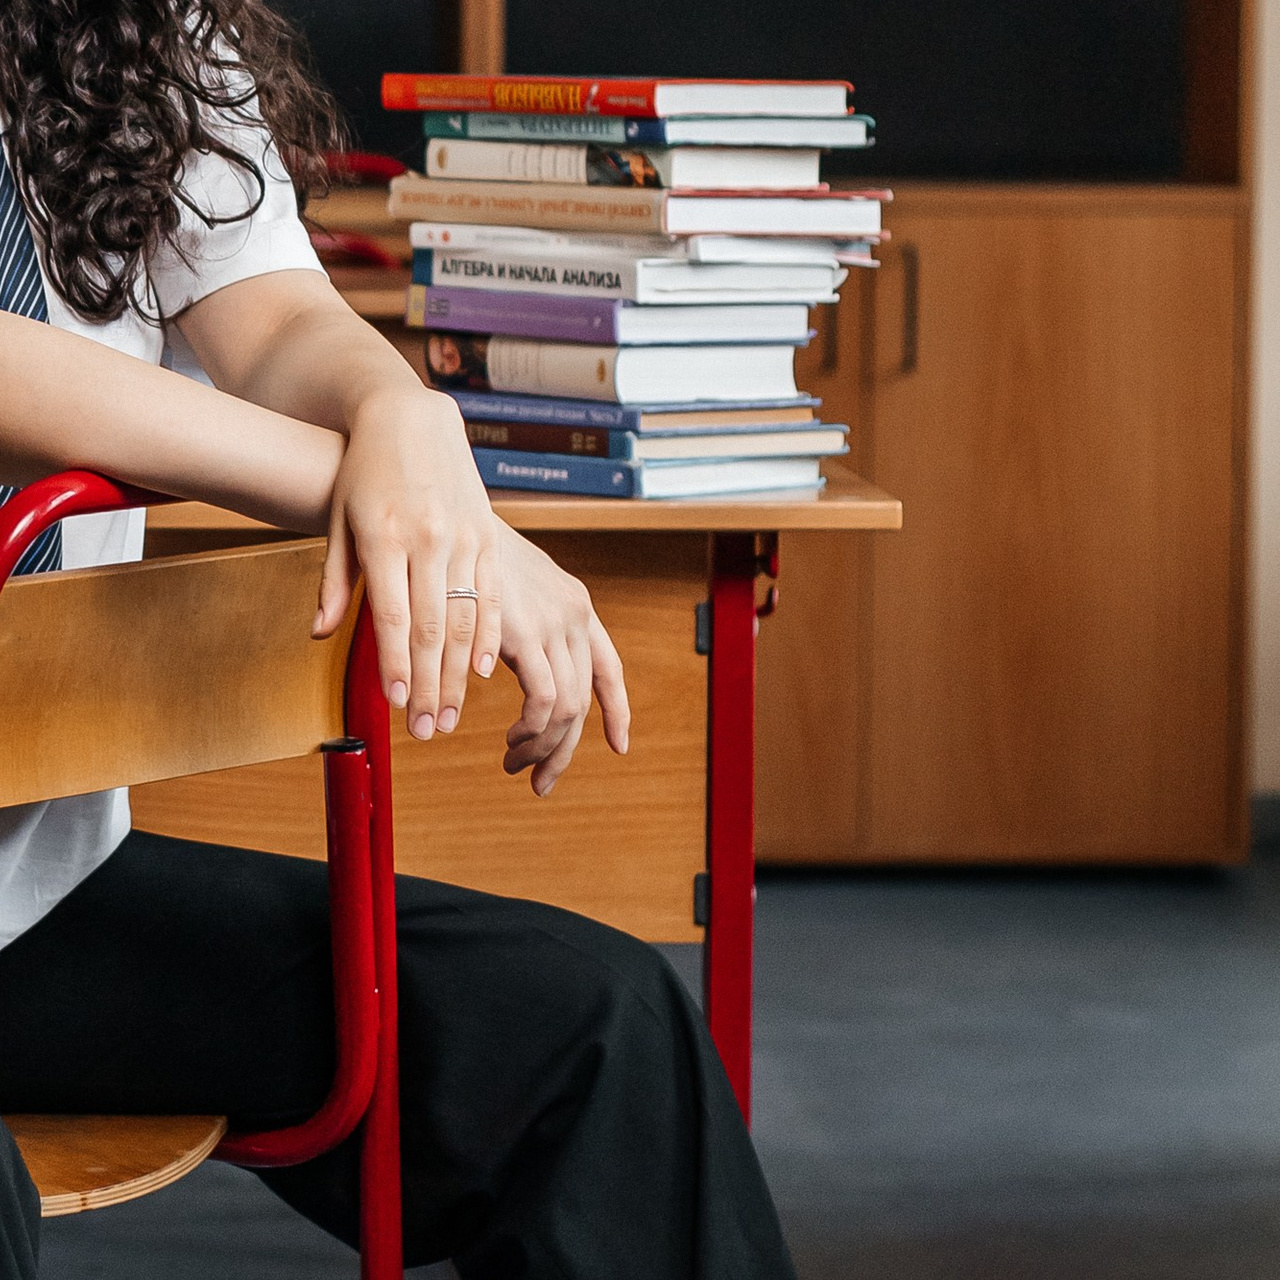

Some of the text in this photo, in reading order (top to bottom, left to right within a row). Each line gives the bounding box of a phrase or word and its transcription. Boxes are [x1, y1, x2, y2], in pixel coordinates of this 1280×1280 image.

[441, 258, 622, 289] АЛГЕБРА И НАЧАЛА АНАЛИЗА
